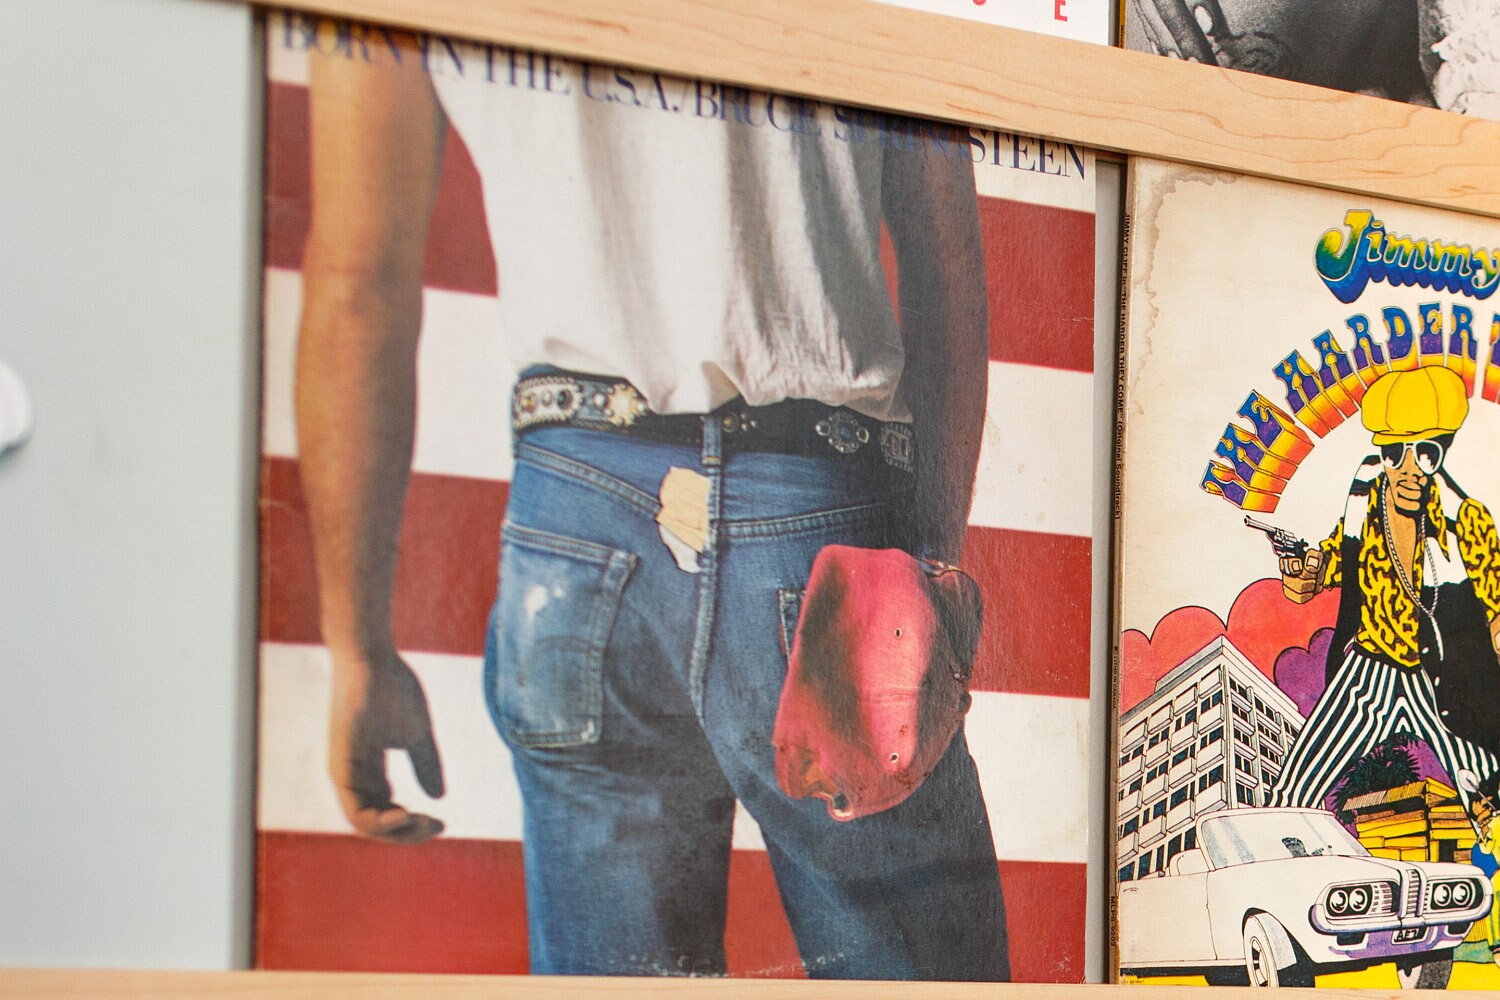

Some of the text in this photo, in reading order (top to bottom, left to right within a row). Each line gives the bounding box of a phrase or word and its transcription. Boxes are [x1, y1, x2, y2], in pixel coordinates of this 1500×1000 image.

[421, 32, 466, 78] IN
[477, 45, 572, 96] THE
[1123, 212, 1131, 244] JIMMY
[1121, 246, 1129, 273] CLIFF
[1118, 313, 1126, 354] HARDER
[1117, 355, 1126, 381] THEY
[1199, 389, 1315, 514] THE
[1272, 301, 1479, 438] HARDER
